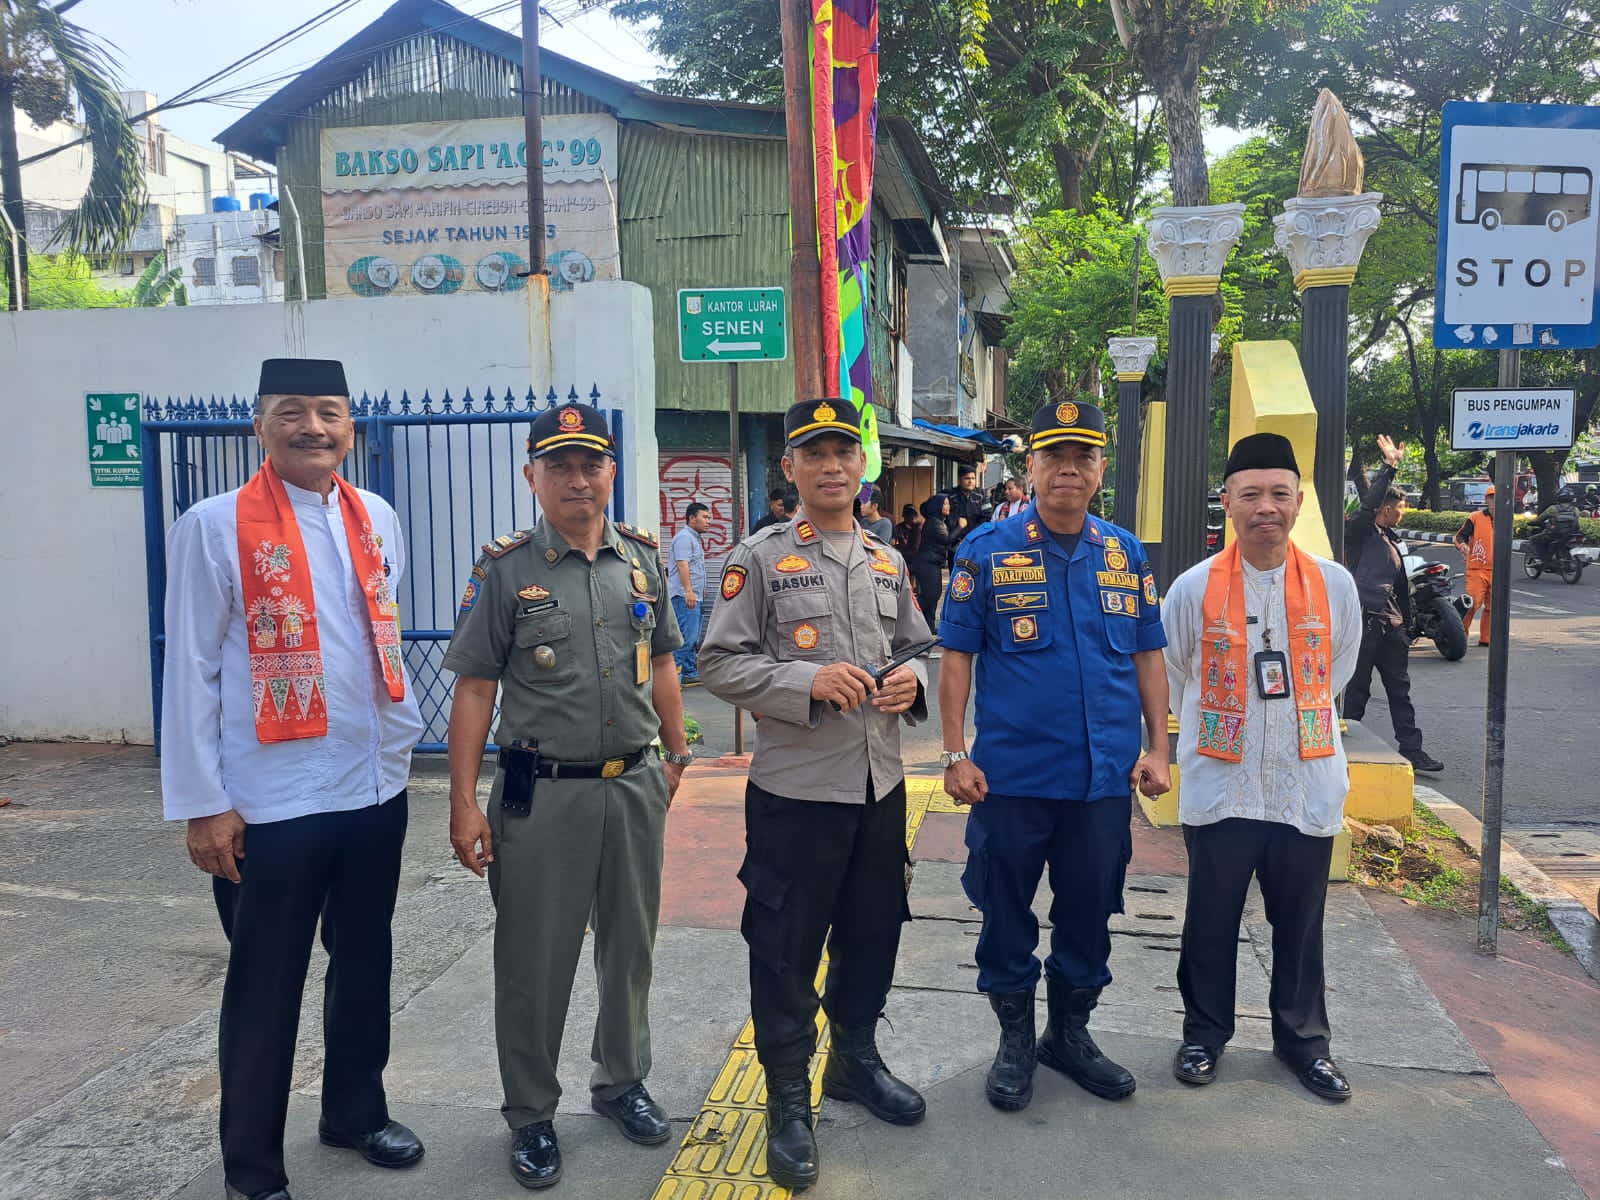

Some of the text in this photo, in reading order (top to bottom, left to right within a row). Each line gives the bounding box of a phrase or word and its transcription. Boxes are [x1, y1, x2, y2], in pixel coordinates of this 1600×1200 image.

[336, 148, 418, 177] BAKSO
[428, 143, 485, 172] SAPI
[569, 137, 602, 167] 99
[383, 223, 557, 245] SEJAK TAHUN 193
[1456, 257, 1586, 288] STOP
[707, 299, 778, 313] KANTOR LURAH
[702, 320, 764, 336] SENEN
[1468, 399, 1560, 411] BUS PENGUMPAN
[1485, 423, 1559, 439] transjakarta
[771, 574, 825, 592] BASUKI
